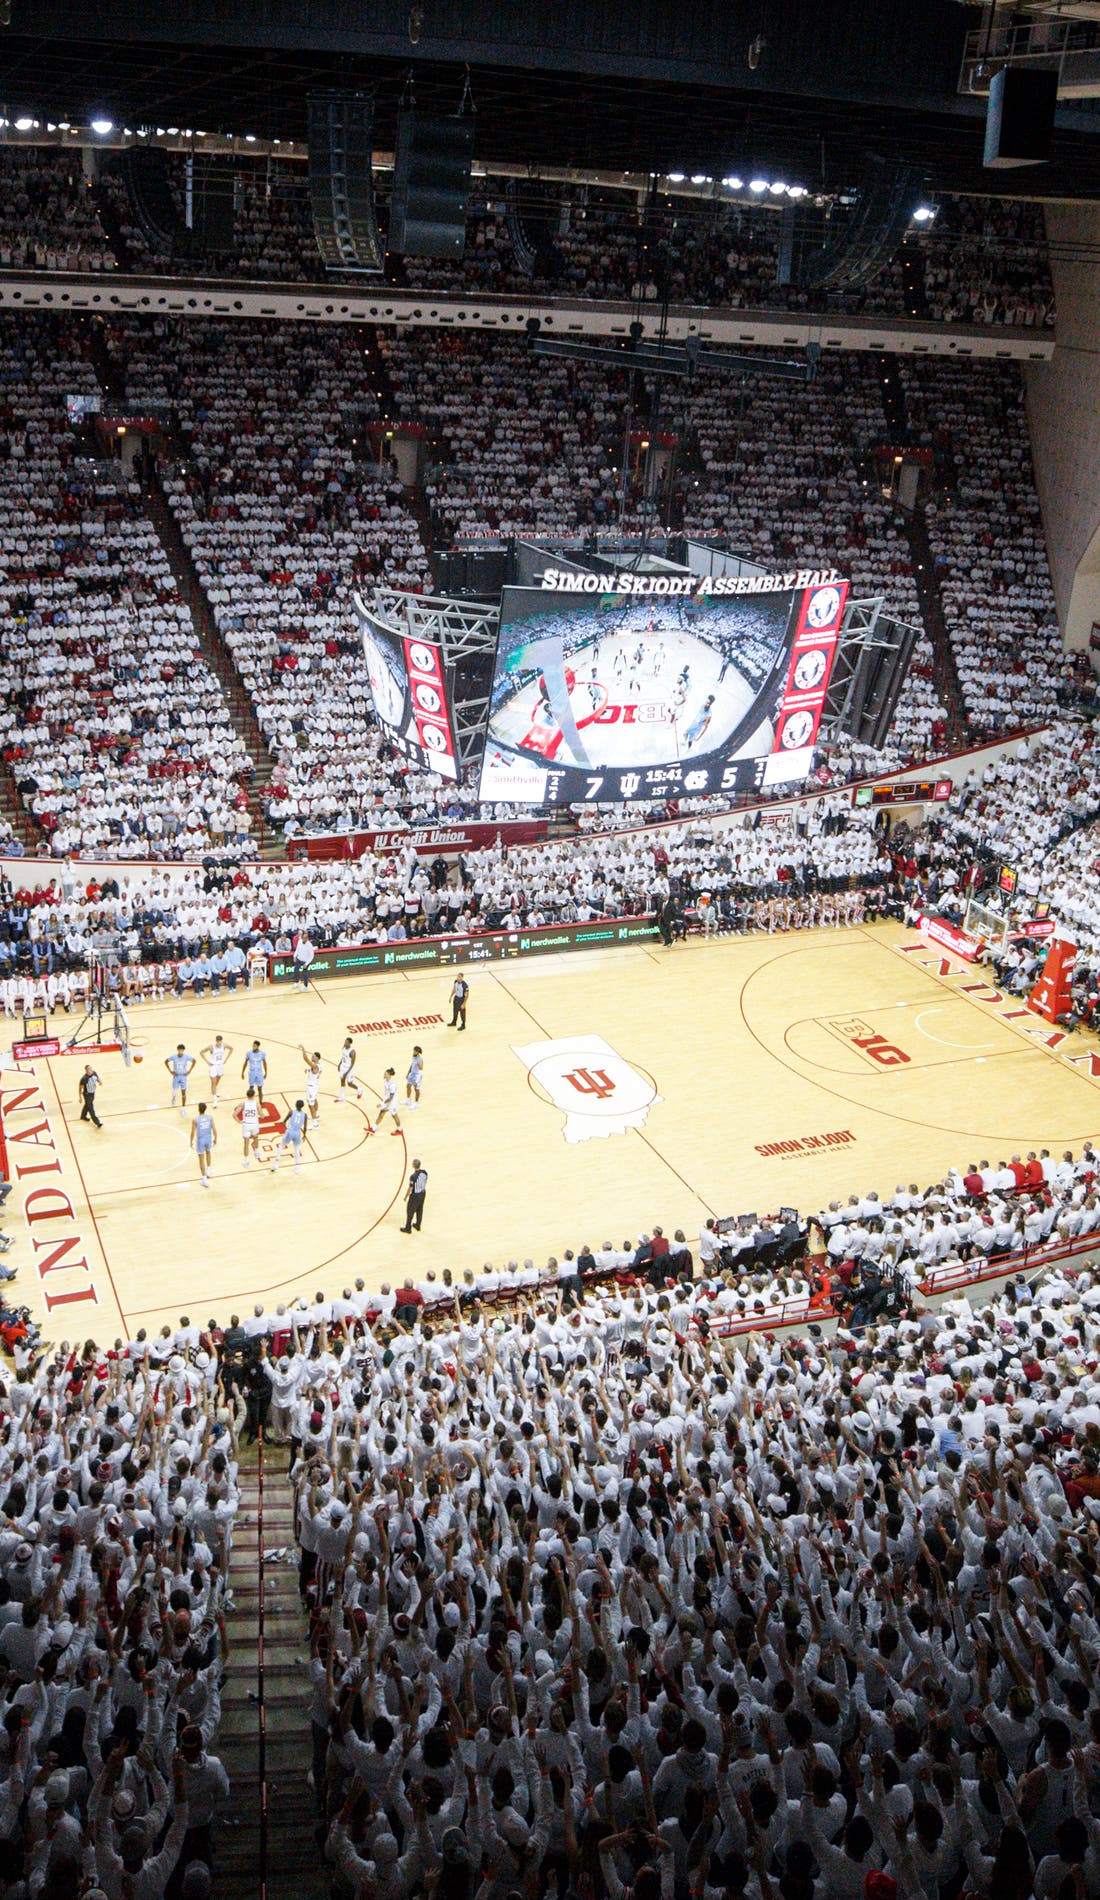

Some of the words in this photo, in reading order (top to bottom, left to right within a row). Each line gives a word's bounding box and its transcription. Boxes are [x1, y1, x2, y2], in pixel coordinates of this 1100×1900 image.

[541, 568, 613, 593] SIMON
[698, 572, 795, 595] ASSEMBLY
[794, 568, 840, 589] HALL
[645, 768, 683, 783] 15:41
[721, 767, 738, 788] 5
[585, 777, 603, 799] 7
[652, 786, 668, 796] 1ST
[761, 814, 791, 825] ESPN
[374, 834, 388, 848] IU
[391, 832, 429, 846] Credit
[430, 829, 466, 843] Union
[346, 1020, 393, 1034] SIMON
[393, 1014, 445, 1028] SKJODT
[244, 1109, 256, 1118] 25
[754, 1139, 805, 1157] SIMON
[801, 1130, 857, 1149] SKJODT
[781, 1149, 827, 1160] ASSEMBLY
[829, 1144, 853, 1153] HALL
